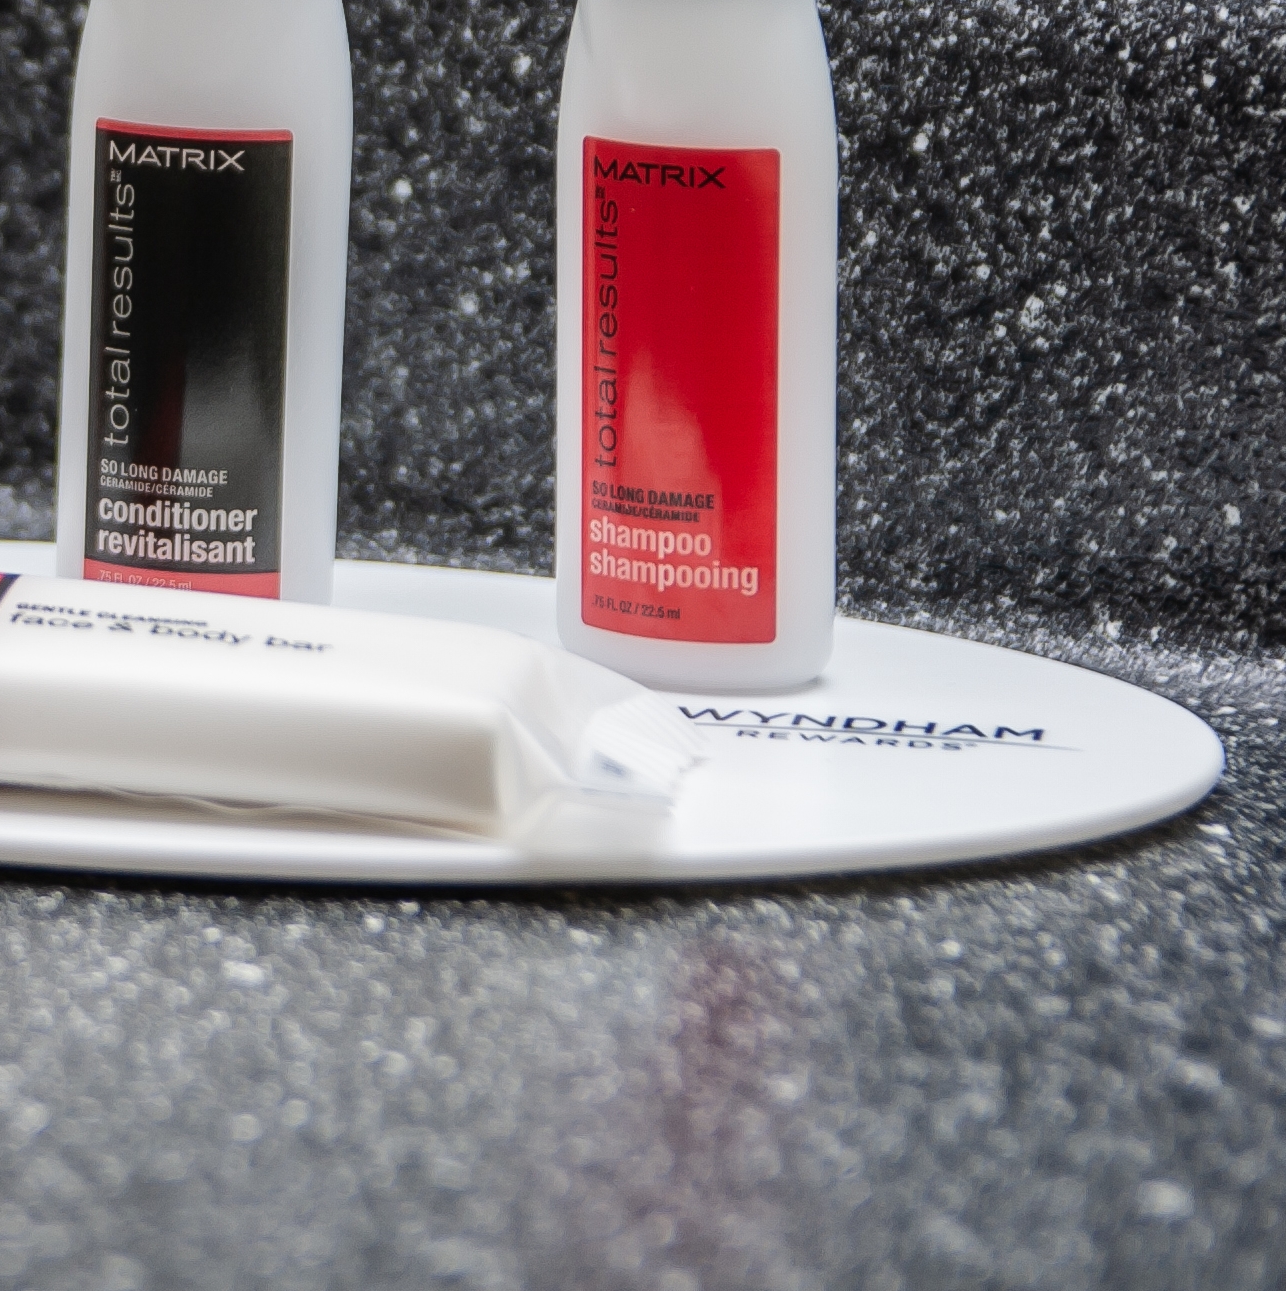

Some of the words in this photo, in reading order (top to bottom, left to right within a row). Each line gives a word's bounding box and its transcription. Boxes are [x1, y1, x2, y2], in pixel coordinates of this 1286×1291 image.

[109, 139, 246, 172] MATRIX
[594, 155, 727, 189] MATRIX
[103, 345, 131, 446] total
[594, 364, 618, 468] total
[100, 458, 118, 475] SO
[120, 461, 158, 480] LONG
[162, 467, 228, 485] DAMAGE
[592, 480, 608, 497] SO
[609, 484, 645, 504] LONG
[647, 489, 715, 510] DAMAGE
[98, 496, 258, 532] conditioner
[97, 528, 256, 564] revitalisant
[590, 515, 713, 560] shampoo
[590, 548, 760, 597] shampooing
[10, 610, 94, 630] face
[108, 621, 133, 634] &
[150, 623, 252, 646] body
[264, 635, 333, 652] bar
[667, 607, 681, 620] ml
[677, 705, 1046, 742] WYNDHAM
